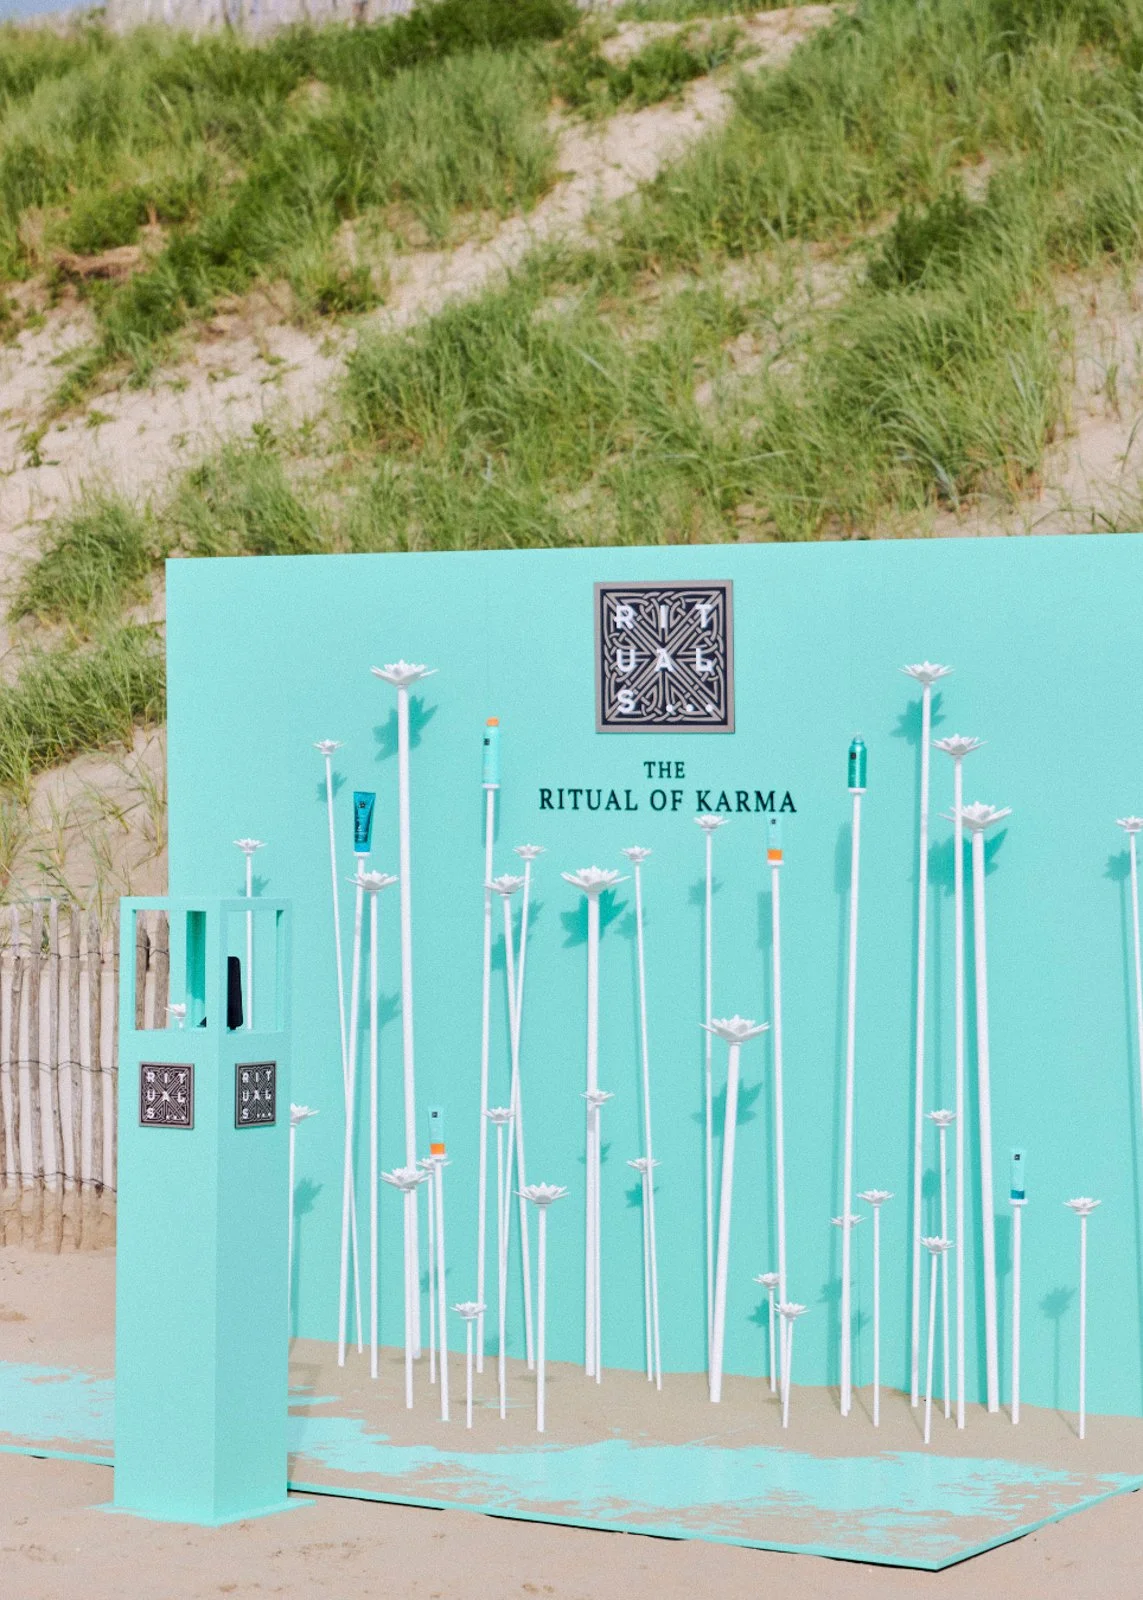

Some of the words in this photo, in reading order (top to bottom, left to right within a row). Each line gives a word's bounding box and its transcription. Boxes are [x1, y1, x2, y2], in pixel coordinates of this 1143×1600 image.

[614, 604, 713, 629] RIT
[616, 648, 714, 673] UAL
[643, 761, 686, 779] THE
[539, 788, 638, 811] RITUAL
[649, 789, 683, 811] OF
[696, 790, 797, 813] KARMA
